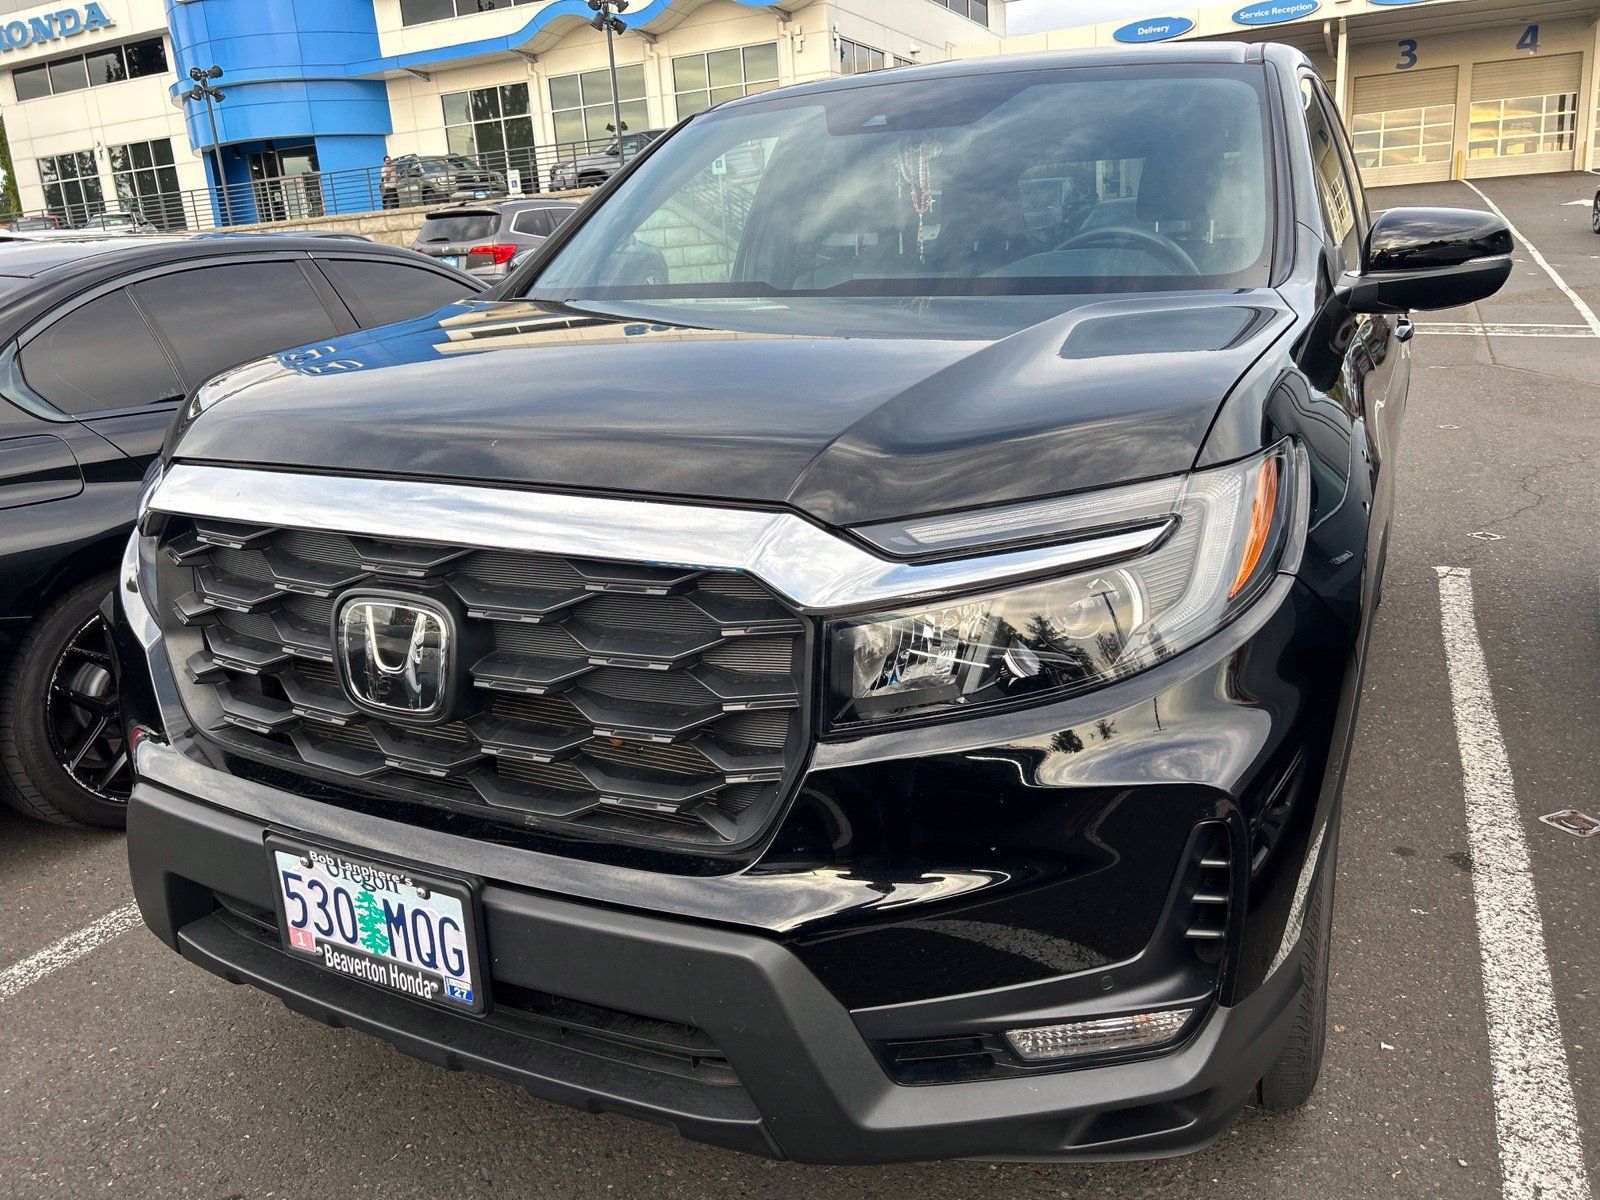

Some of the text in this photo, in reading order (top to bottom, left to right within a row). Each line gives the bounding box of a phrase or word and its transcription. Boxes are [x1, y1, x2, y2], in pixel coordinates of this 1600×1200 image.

[1240, 3, 1313, 20] Service Reception
[1137, 24, 1170, 36] Delivery
[1516, 24, 1540, 54] 4
[1396, 39, 1418, 69] 3
[309, 850, 413, 887] Bob Lanphere's
[282, 870, 464, 977] 530 MQG
[297, 931, 307, 947] 1
[324, 944, 433, 999] Beaverton Honda
[453, 987, 468, 999] 27
